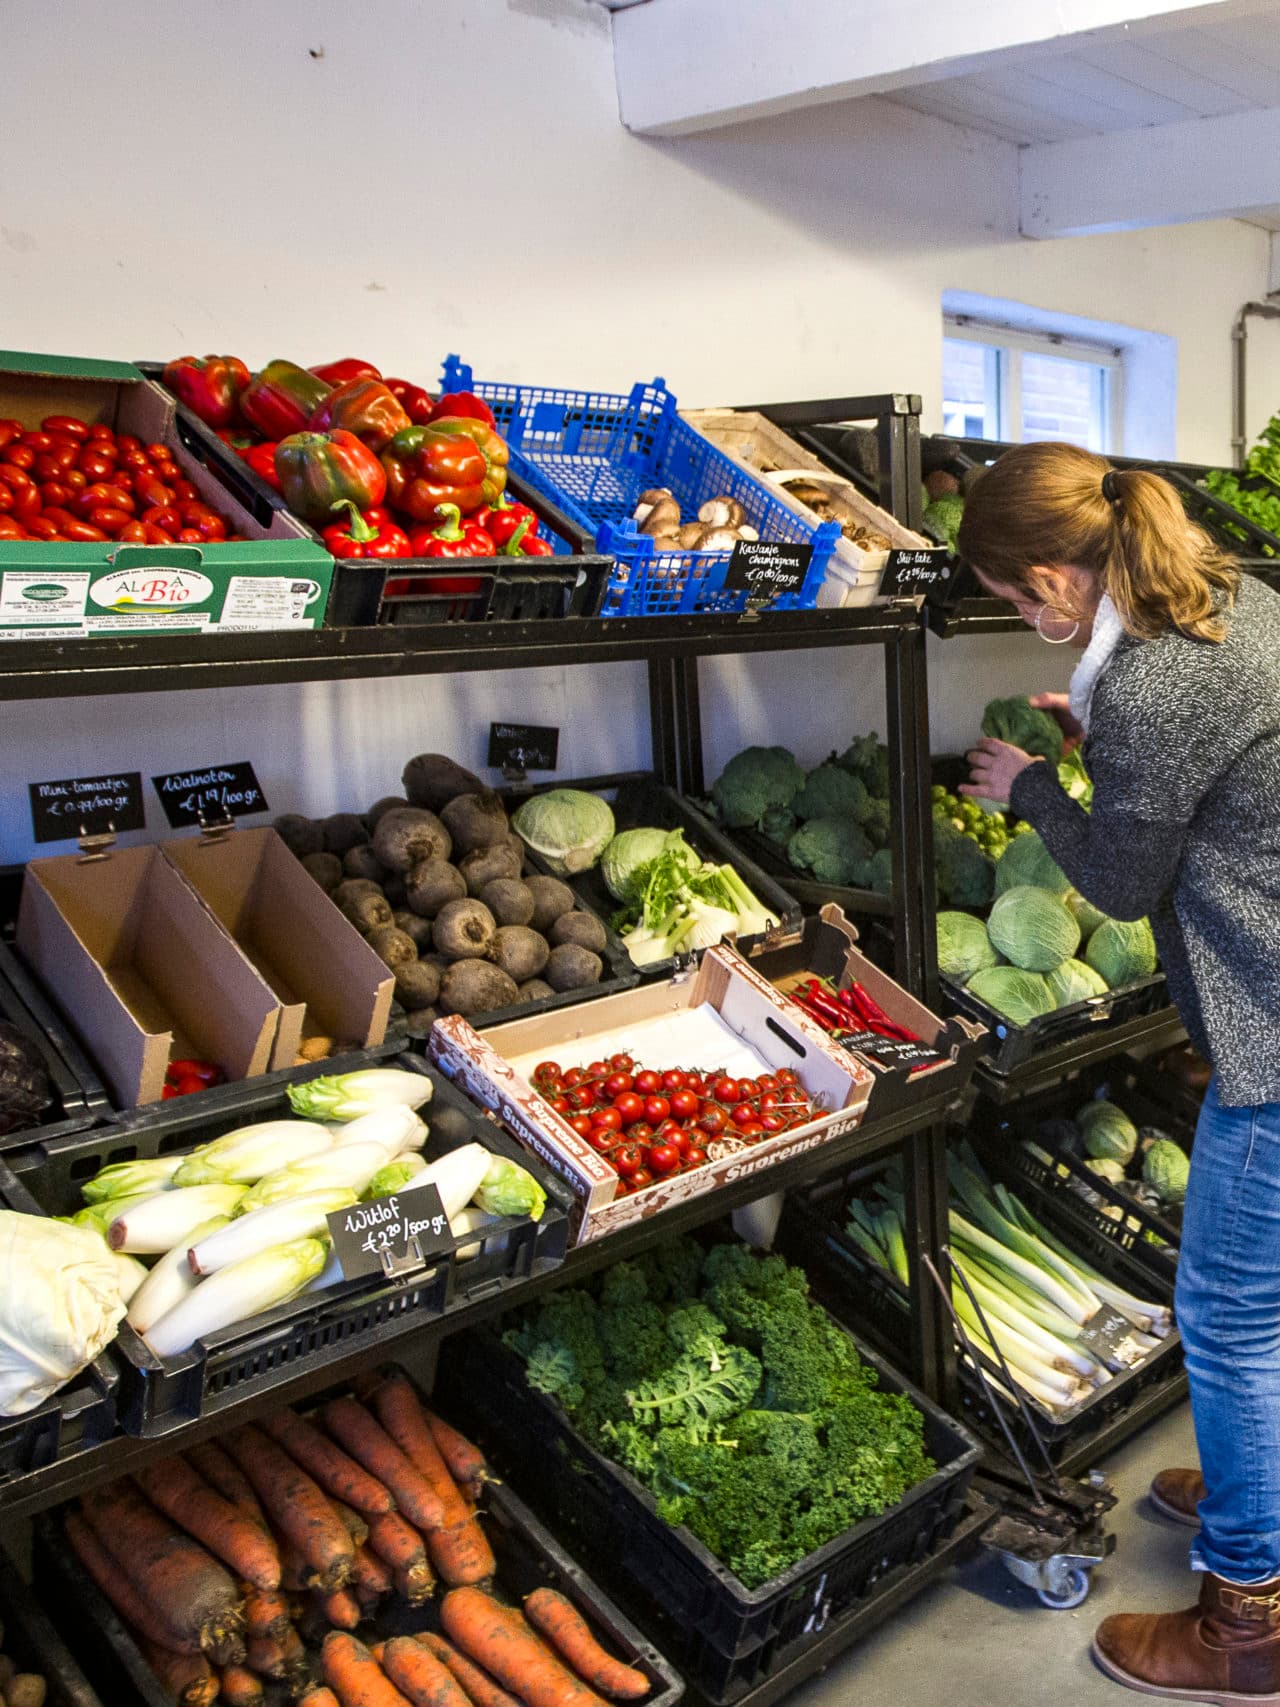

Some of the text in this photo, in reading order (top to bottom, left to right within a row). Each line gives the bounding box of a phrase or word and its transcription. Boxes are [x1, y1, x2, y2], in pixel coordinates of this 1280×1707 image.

[163, 767, 236, 793] Walnoten
[526, 1099, 606, 1179] Supreme Bio
[824, 1117, 858, 1143] Bio
[501, 1103, 587, 1198] Supreme Bio
[344, 1196, 401, 1233] Witlof
